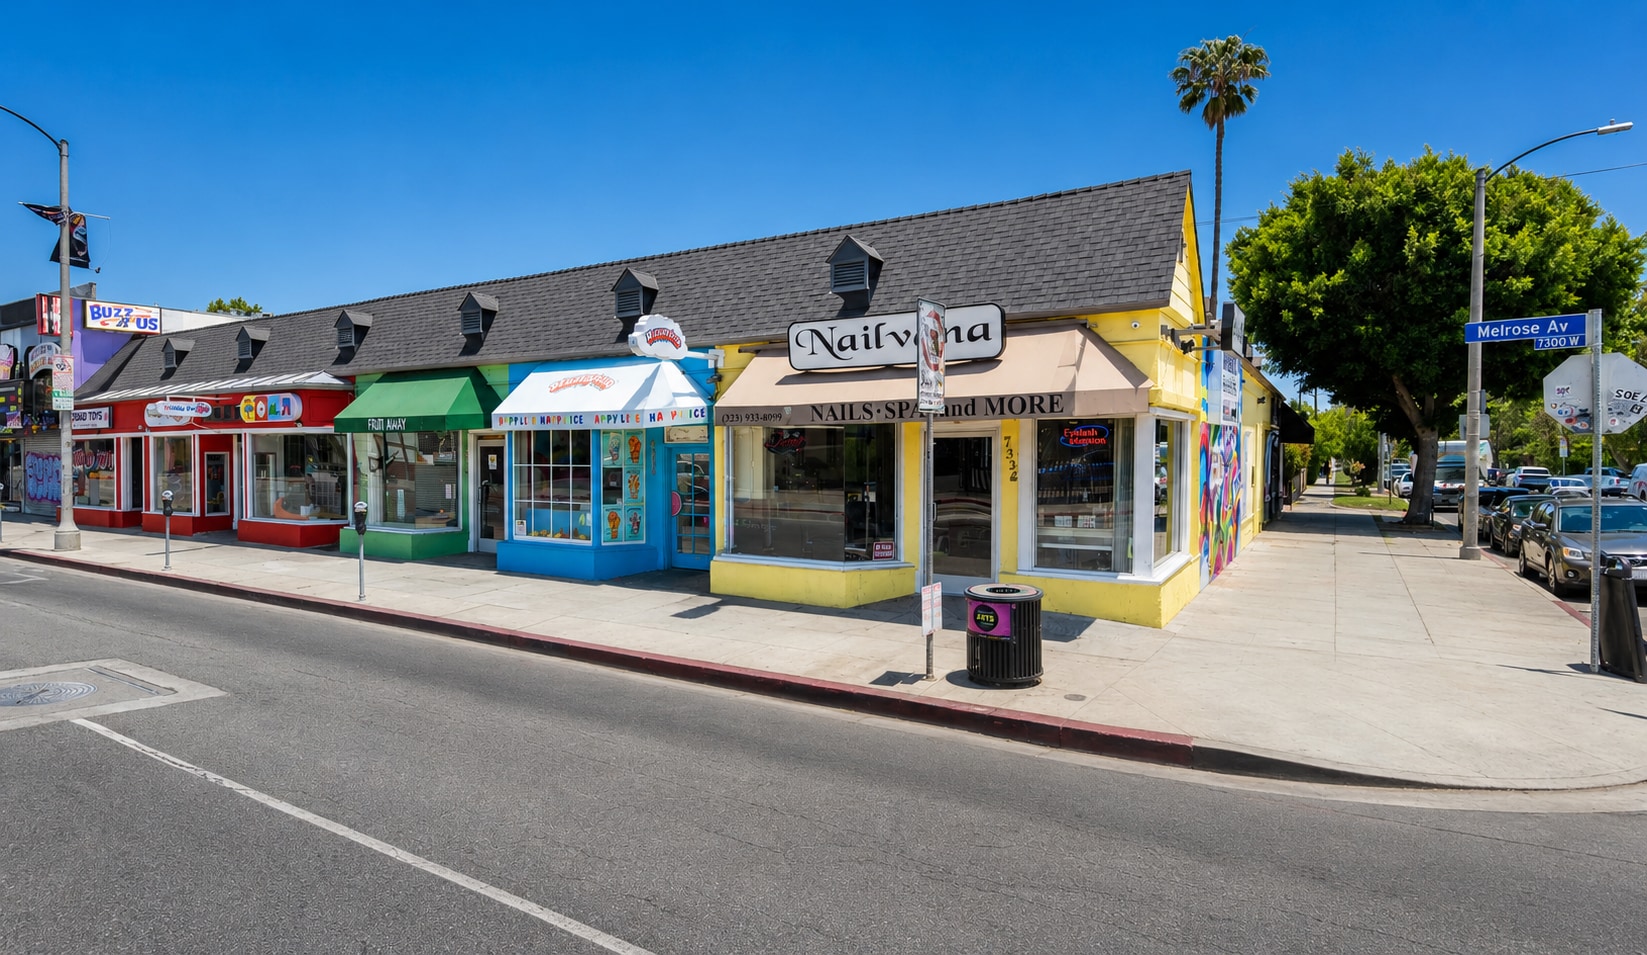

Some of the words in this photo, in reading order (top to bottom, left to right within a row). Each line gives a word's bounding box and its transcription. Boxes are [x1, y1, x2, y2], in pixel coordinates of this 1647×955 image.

[90, 305, 134, 320] BUZZ
[136, 317, 158, 330] US
[1477, 324, 1540, 338] Melrose
[1547, 320, 1569, 333] Av
[795, 321, 993, 361] Nailvna
[1538, 338, 1567, 348] 7300
[1568, 336, 1580, 346] W
[984, 394, 1065, 416] MORE
